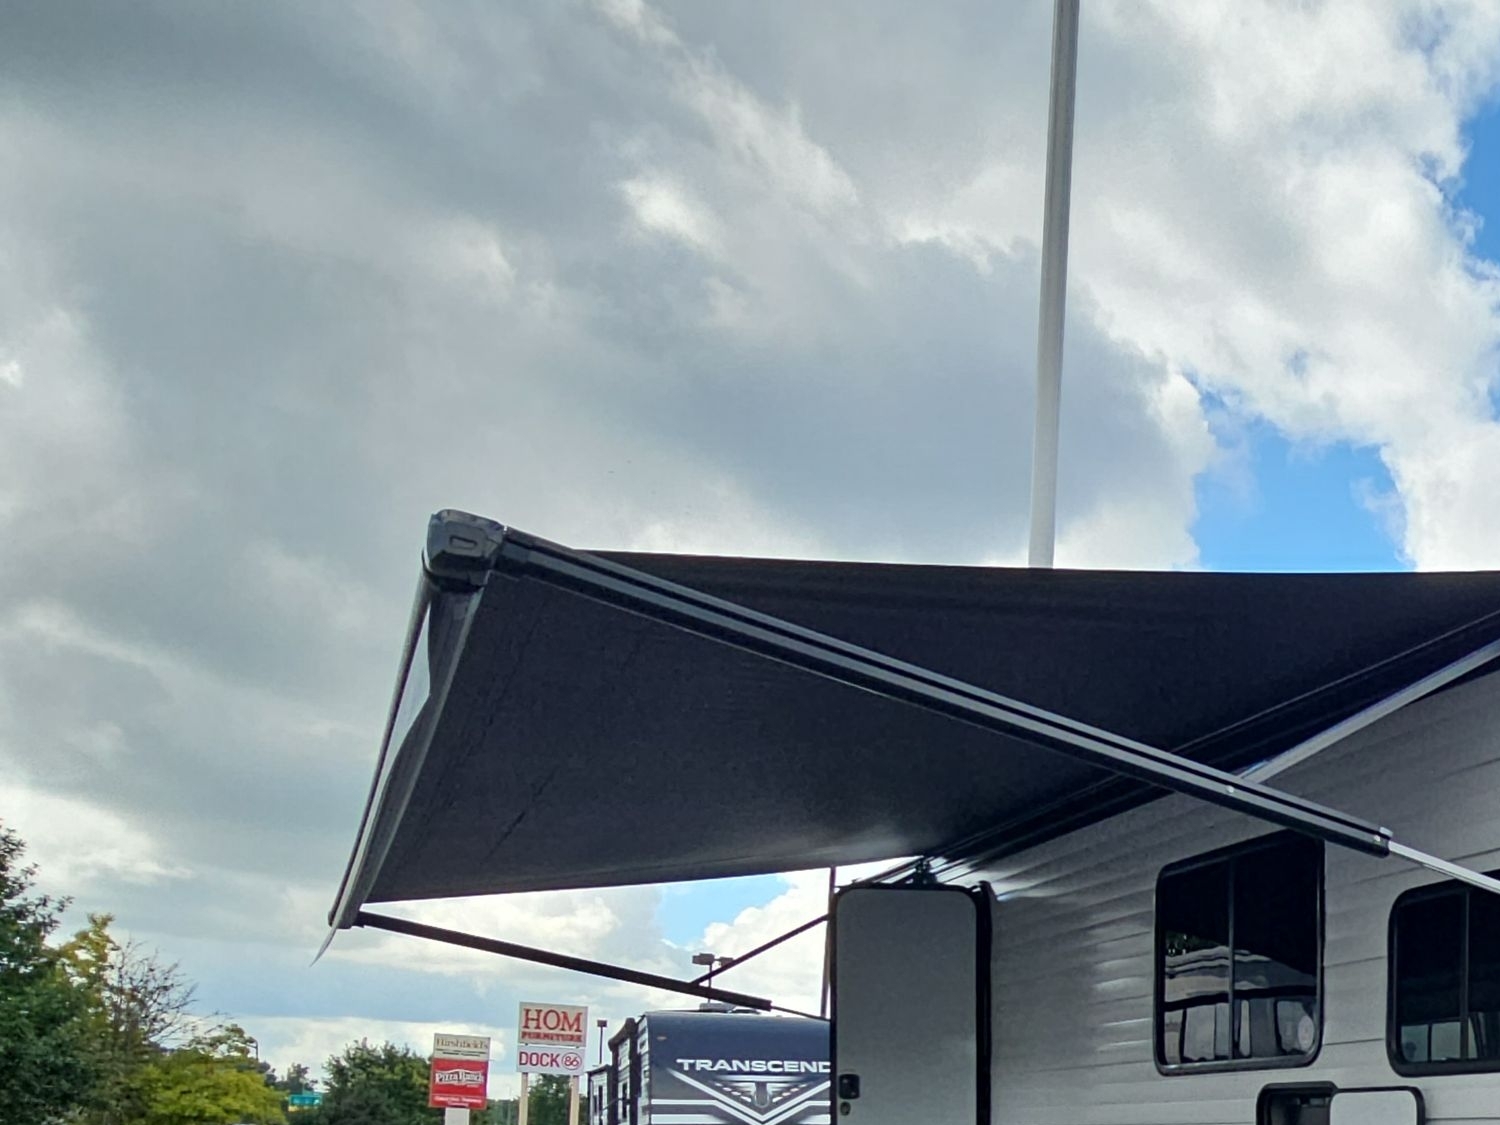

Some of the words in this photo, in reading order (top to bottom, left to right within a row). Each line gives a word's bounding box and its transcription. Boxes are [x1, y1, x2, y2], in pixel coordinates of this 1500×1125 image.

[522, 1008, 583, 1033] HOM
[519, 1051, 560, 1068] DOCK
[564, 1056, 579, 1067] 86
